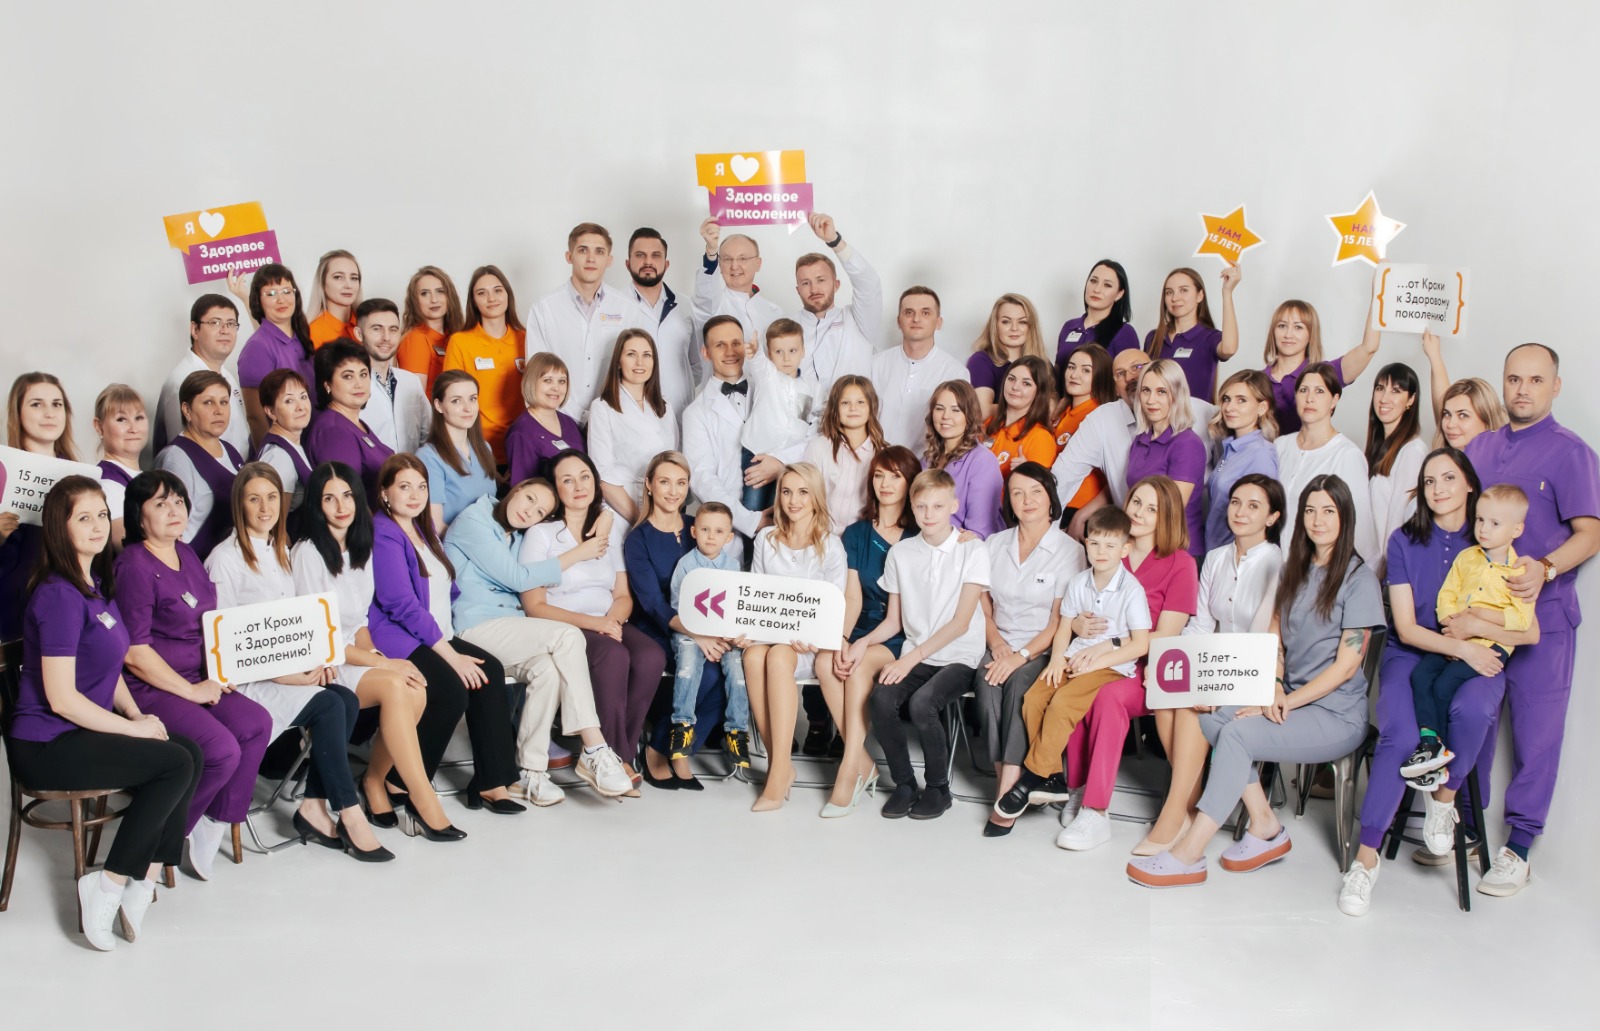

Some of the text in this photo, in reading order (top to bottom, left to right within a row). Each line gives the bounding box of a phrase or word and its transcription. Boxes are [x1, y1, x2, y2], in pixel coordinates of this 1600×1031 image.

[714, 162, 725, 176] Я
[725, 187, 799, 205] Здоровое
[726, 208, 805, 220] поколение
[184, 221, 195, 235] Я
[1218, 225, 1242, 241] НАМ
[1208, 232, 1242, 253] 15 ЛЕТ!
[1343, 234, 1356, 245] 15
[199, 241, 265, 259] Здоровое
[202, 256, 274, 275] поколение
[1422, 278, 1445, 292] Крохи
[1396, 292, 1450, 310] к Здоровому
[1395, 310, 1447, 322] поколению!
[18, 469, 55, 487] 15 лет
[14, 486, 35, 498] это
[11, 500, 44, 513] начал
[738, 585, 821, 605] 15 лет любим
[737, 600, 817, 619] Ваших детей
[263, 615, 303, 632] Крохи
[735, 616, 801, 632] как своих!
[235, 629, 315, 652] к Здоровому
[236, 642, 312, 668] поколению!
[1197, 652, 1209, 664] 15
[1210, 654, 1231, 663] лет
[1197, 668, 1259, 678] это только
[1197, 683, 1235, 692] начало
